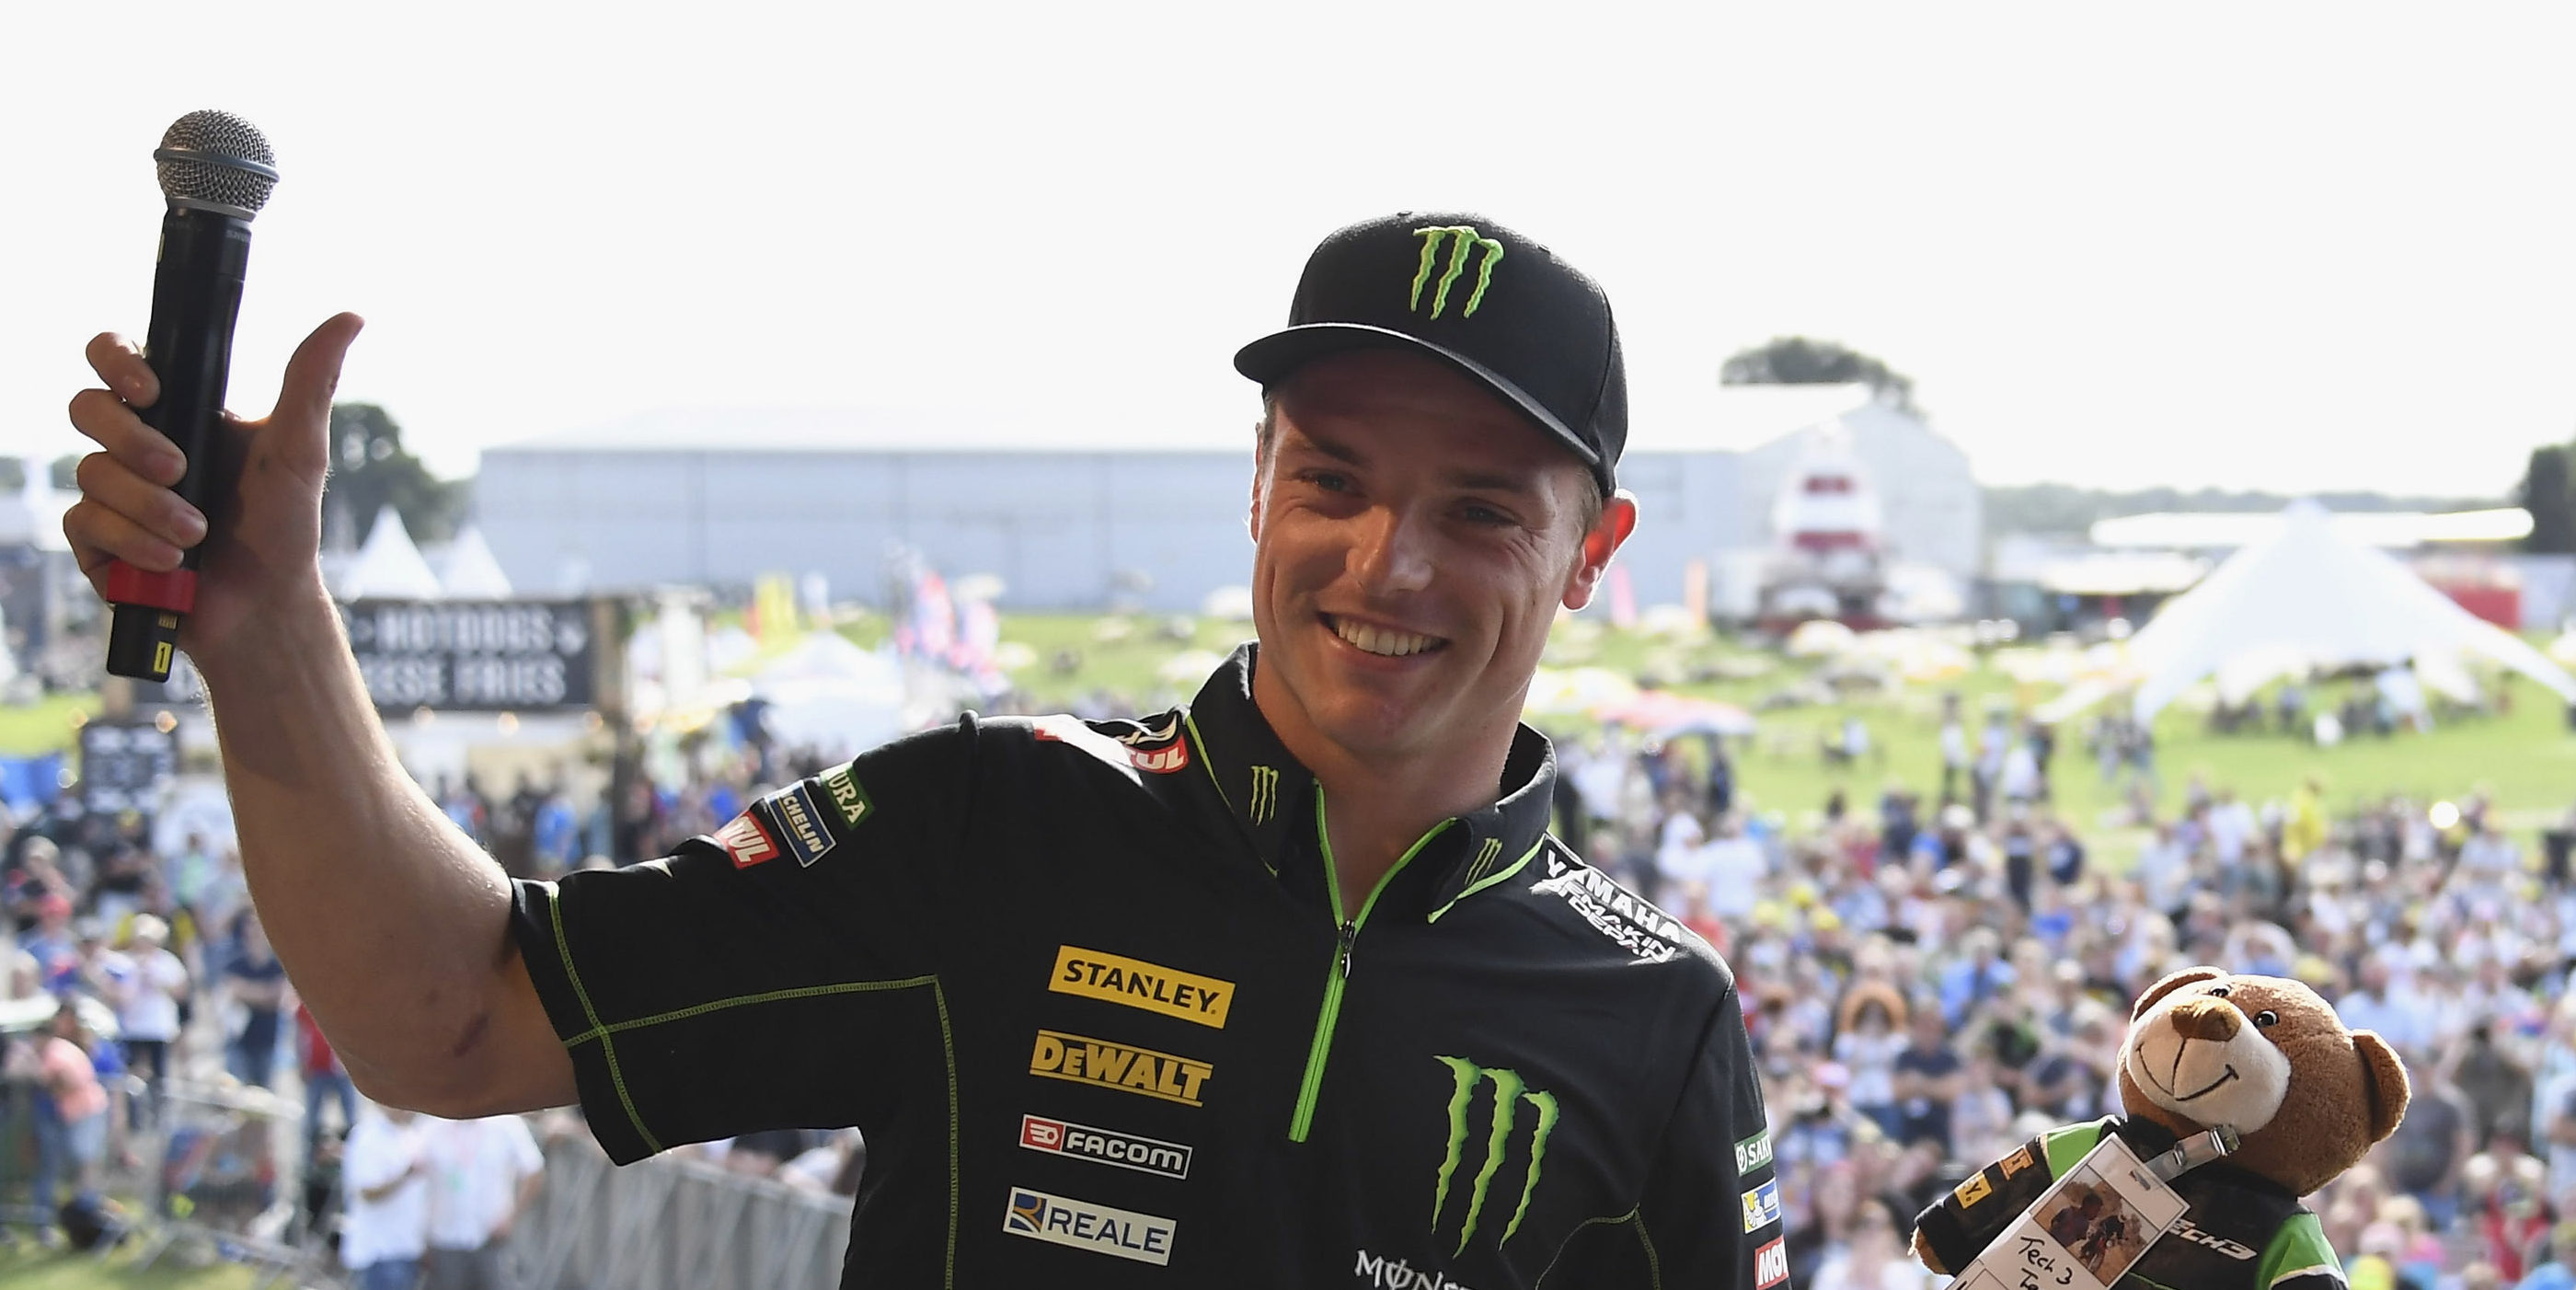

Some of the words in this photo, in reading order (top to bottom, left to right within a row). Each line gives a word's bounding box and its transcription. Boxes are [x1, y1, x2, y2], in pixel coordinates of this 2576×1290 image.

[159, 646, 167, 670] 1
[1547, 849, 1682, 943] YAMAHA
[1063, 959, 1220, 1014] STANLEY
[1066, 1132, 1183, 1171] FACOM
[1047, 1206, 1169, 1254] REALE
